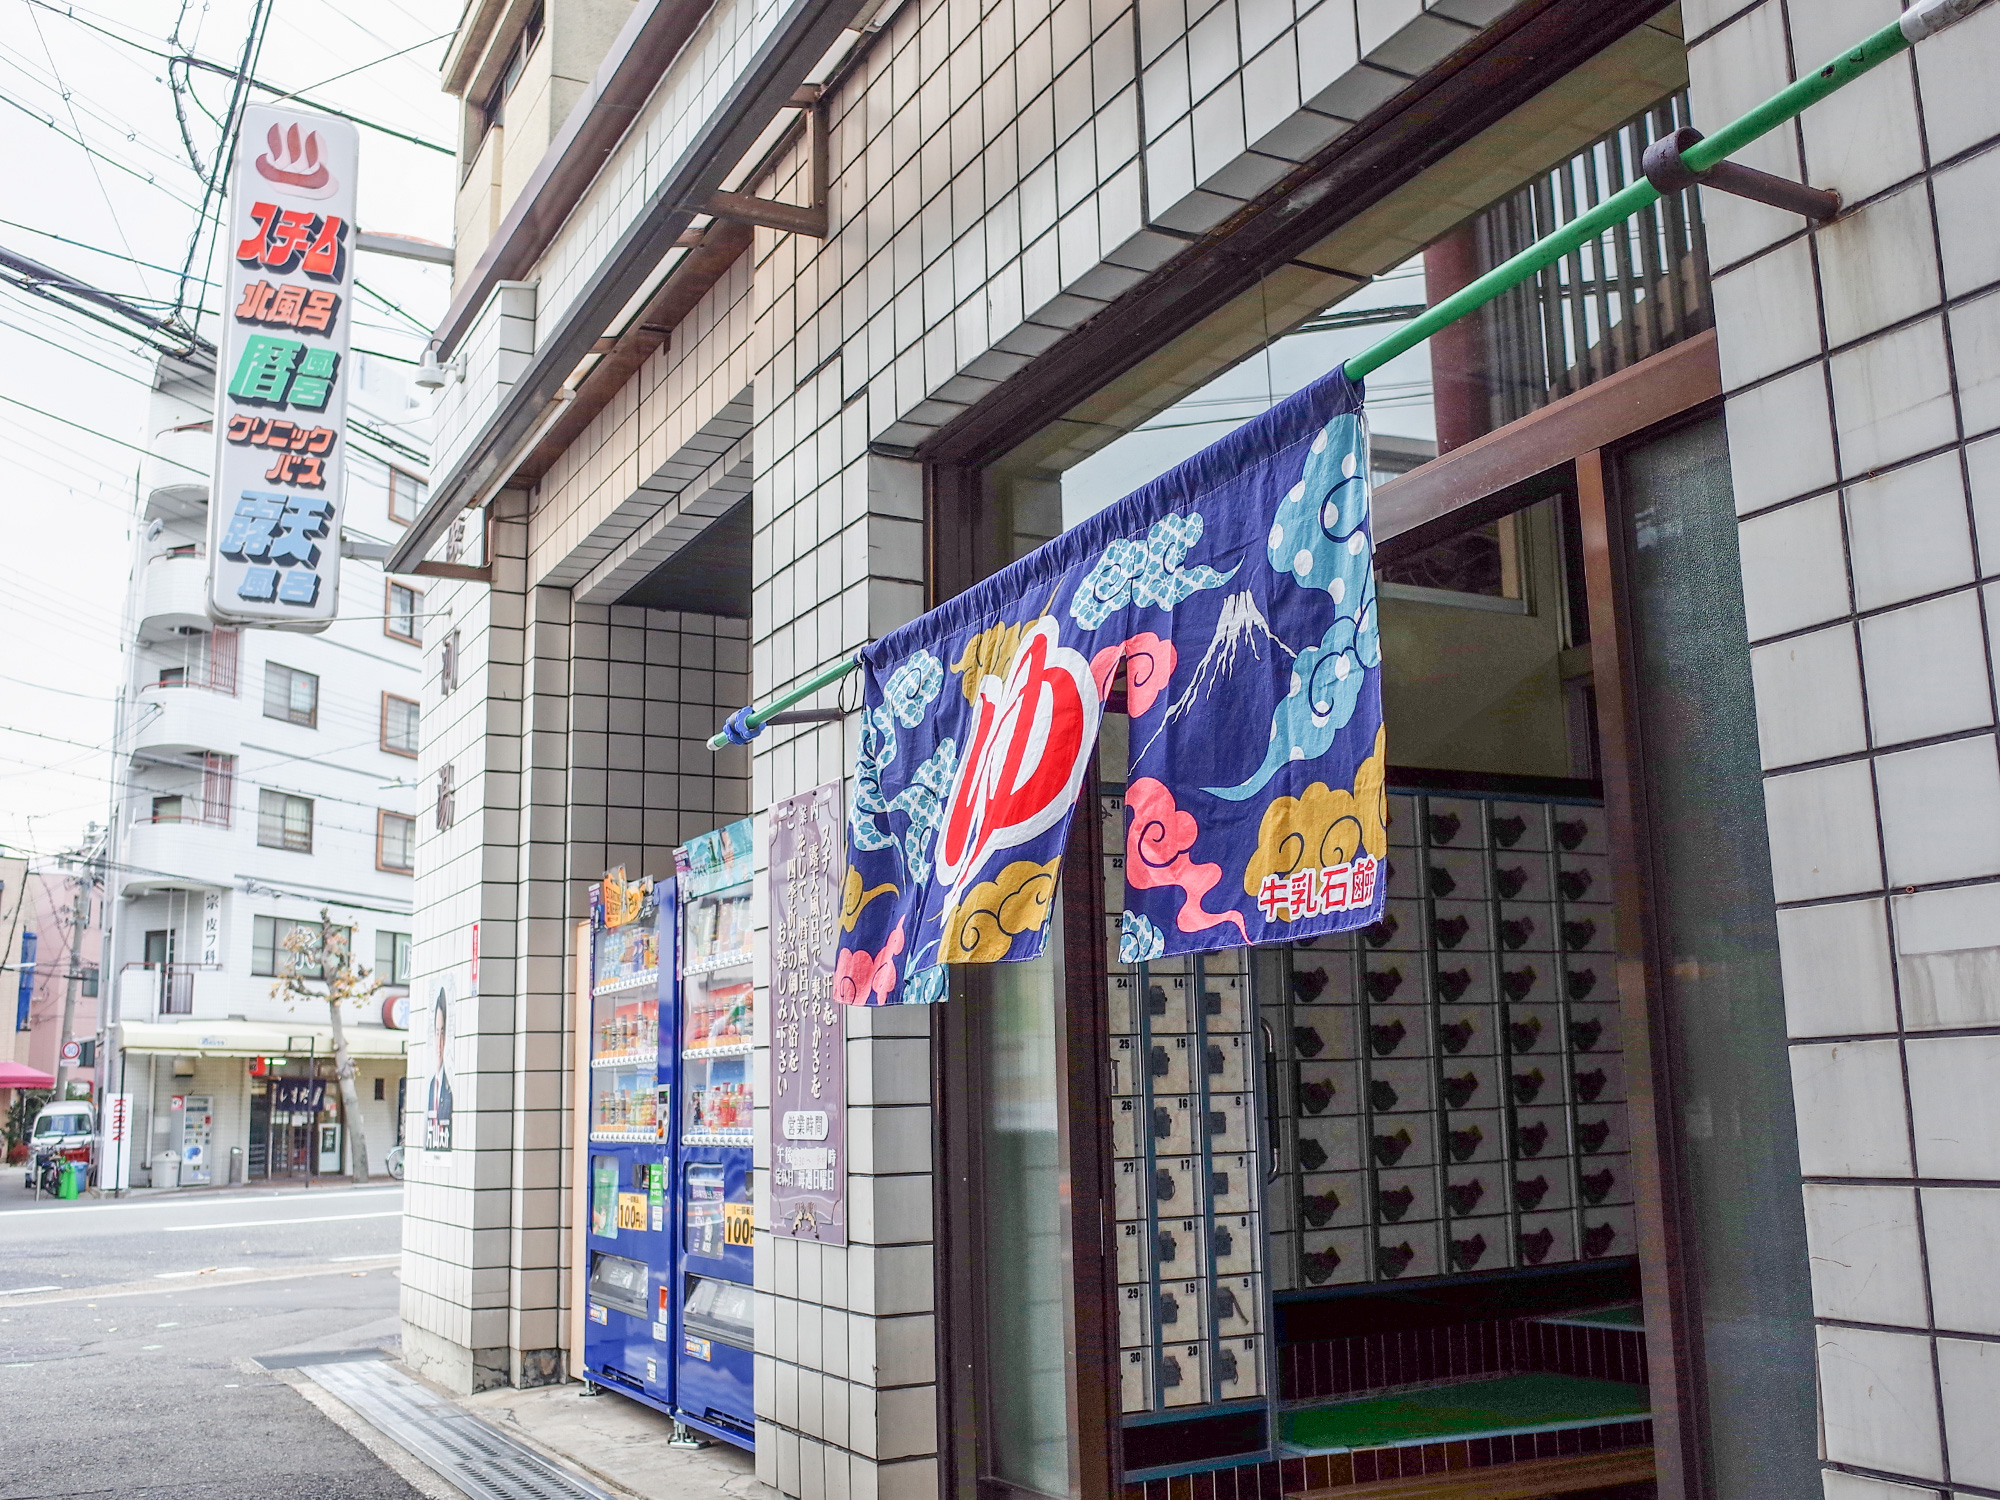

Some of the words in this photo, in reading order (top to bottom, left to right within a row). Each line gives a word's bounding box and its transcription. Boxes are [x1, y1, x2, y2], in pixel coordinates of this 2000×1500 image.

[235, 279, 340, 336] 水風呂
[227, 414, 336, 456] クリニック
[265, 454, 326, 488] バス
[220, 490, 333, 566] 露天
[237, 567, 318, 605] 風呂
[940, 622, 1092, 905] ゆ
[1111, 799, 1121, 810] 21
[1112, 858, 1123, 869] 22
[809, 842, 821, 967] 露天風呂で
[1117, 978, 1128, 989] 24
[1173, 978, 1184, 989] 14
[1119, 1039, 1130, 1050] 25
[1176, 1038, 1186, 1048] 15
[1121, 1100, 1132, 1111] 26
[1178, 1098, 1188, 1109] 16
[112, 1098, 127, 1141] KIRIN
[788, 1115, 823, 1135] 営業時間
[426, 1118, 449, 1149] 片山大介
[1123, 1162, 1134, 1173] 27
[1180, 1159, 1190, 1170] 17
[1125, 1225, 1136, 1236] 28
[1183, 1221, 1193, 1232] 18
[1185, 1282, 1195, 1293] 19
[1127, 1288, 1139, 1299] 29
[1130, 1352, 1141, 1363] 30
